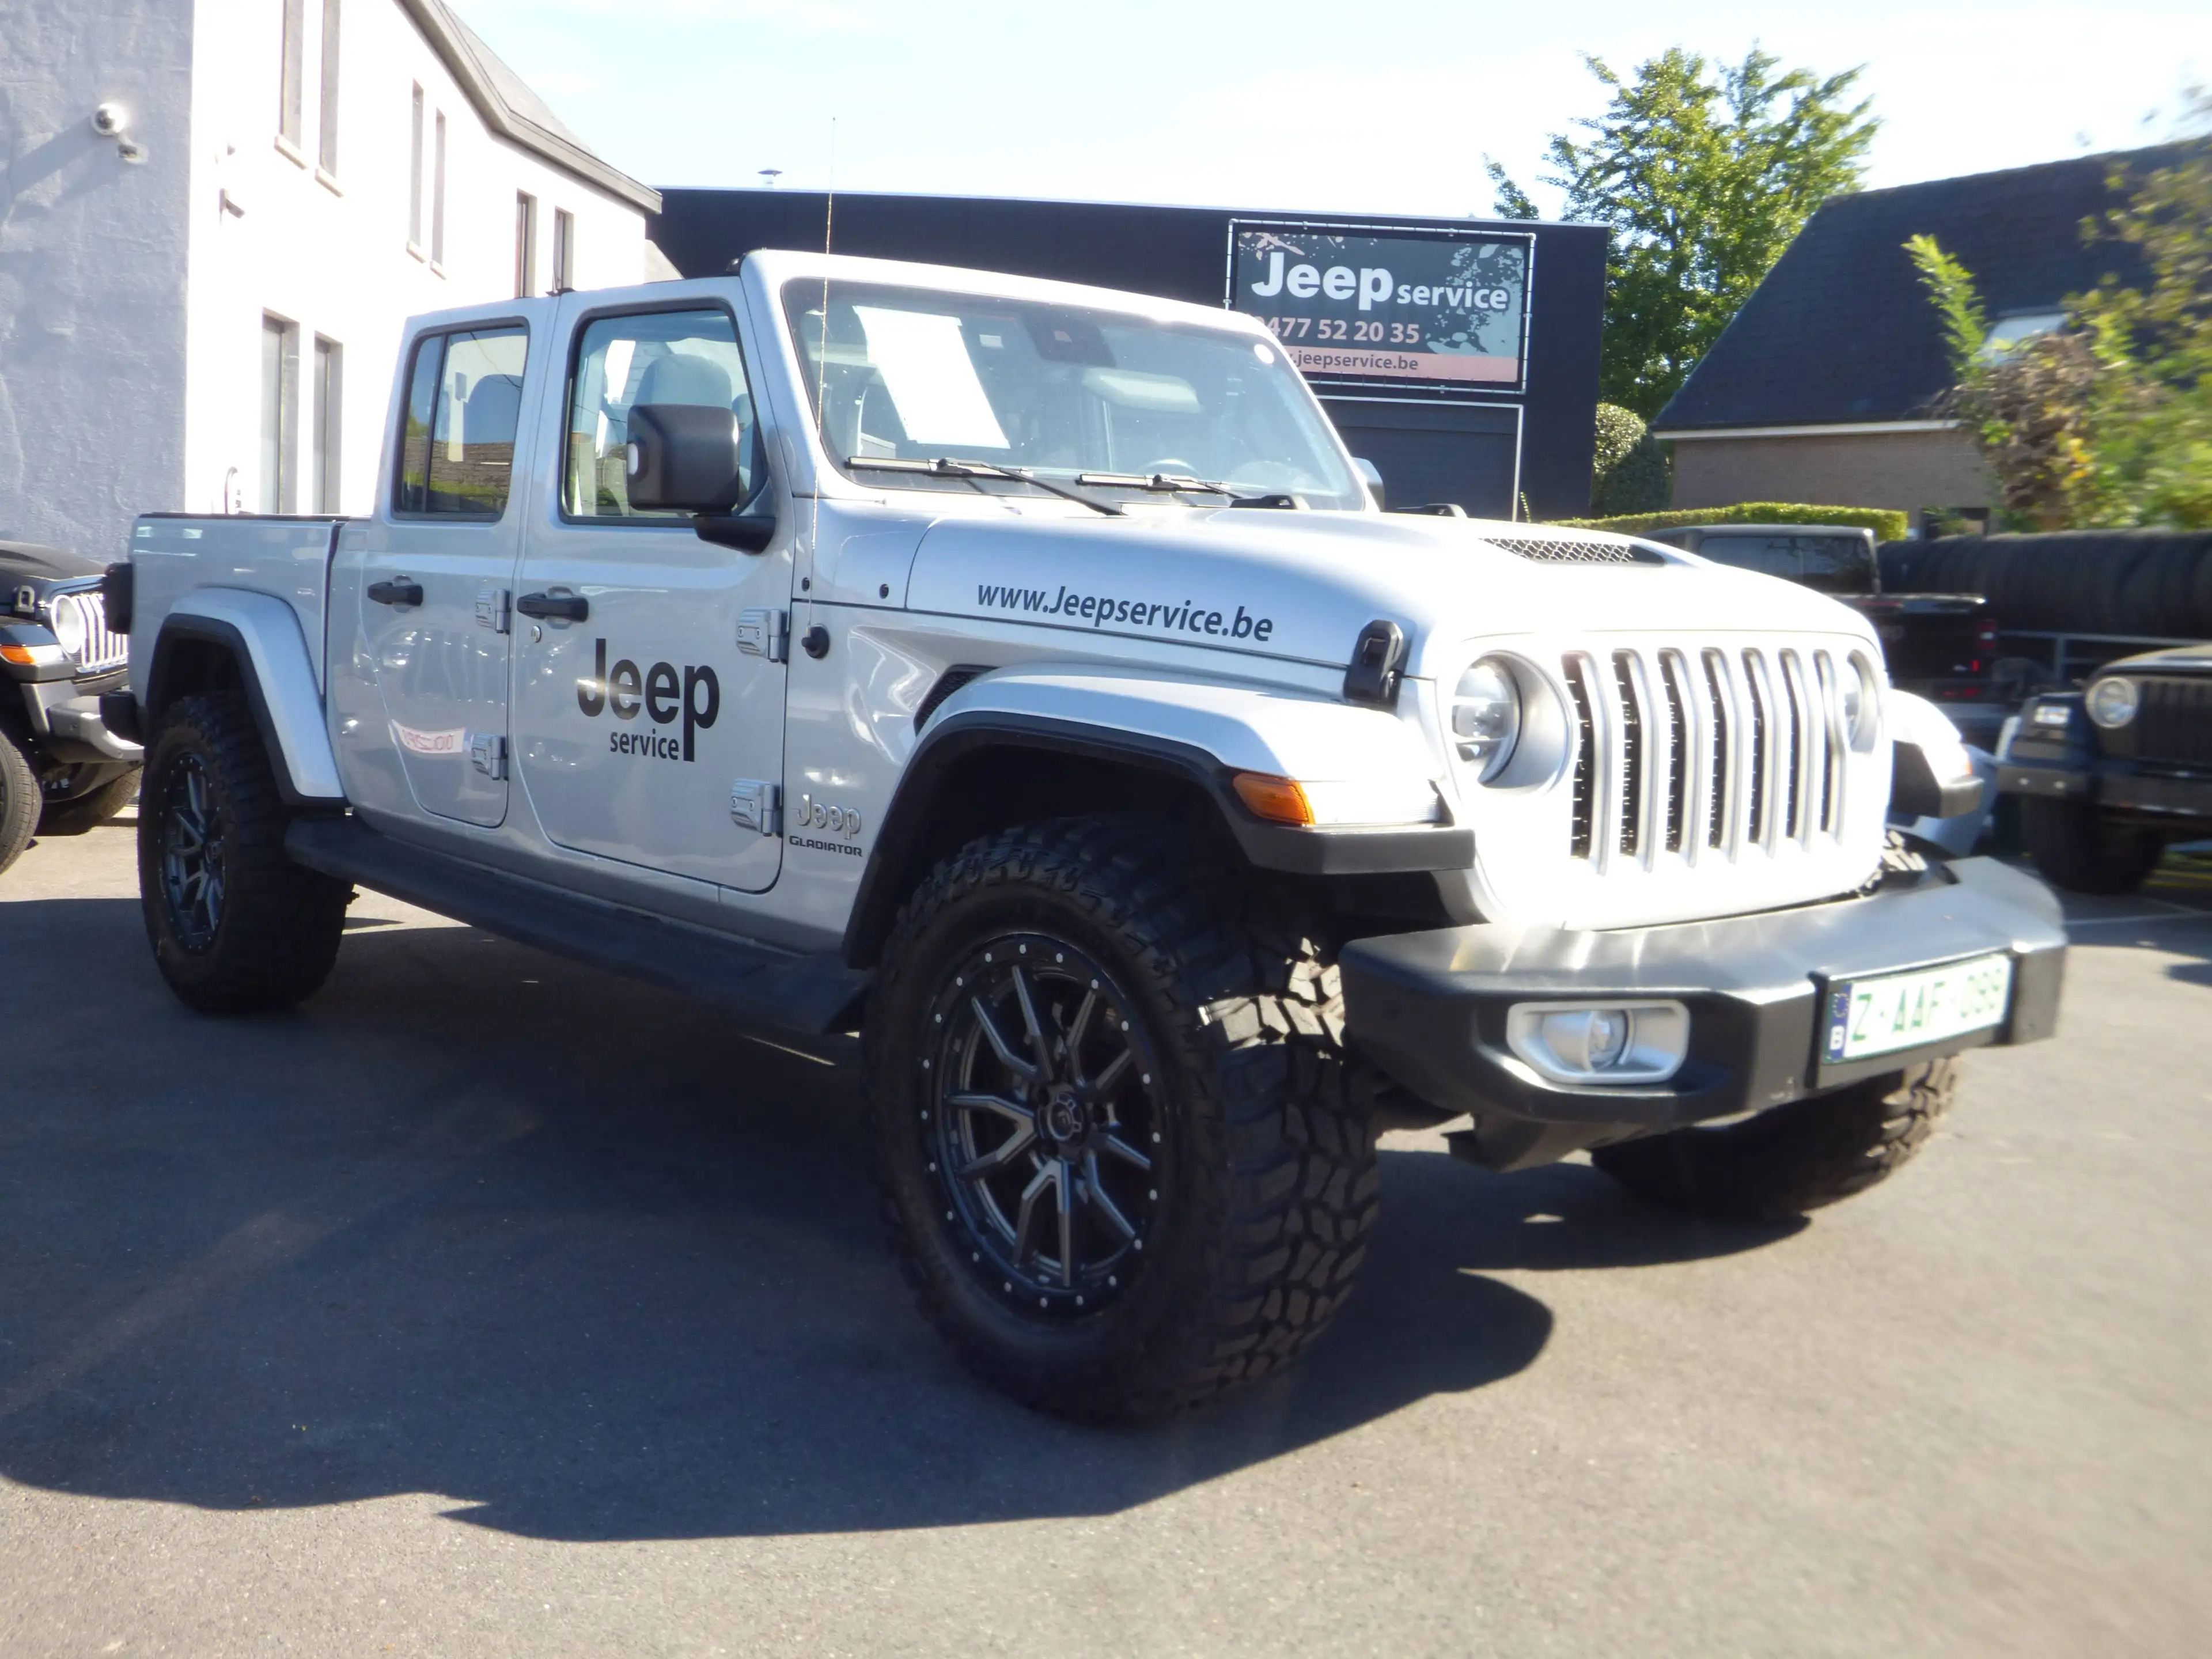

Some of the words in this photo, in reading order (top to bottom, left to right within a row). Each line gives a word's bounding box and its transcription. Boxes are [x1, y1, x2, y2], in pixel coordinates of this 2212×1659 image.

[1251, 252, 1393, 310] Jeep
[1396, 281, 1508, 310] service
[1255, 316, 1311, 338] 477
[1317, 319, 1347, 340] 52
[1354, 320, 1384, 342] 20
[1389, 323, 1420, 344] 35
[1289, 350, 1419, 370] .jeepservice.be
[978, 584, 1274, 642] www.Jeepservice.be
[577, 638, 720, 762] Jeep
[609, 728, 680, 760] service
[792, 793, 861, 840] Jeep
[789, 835, 863, 857] GLADIATOR
